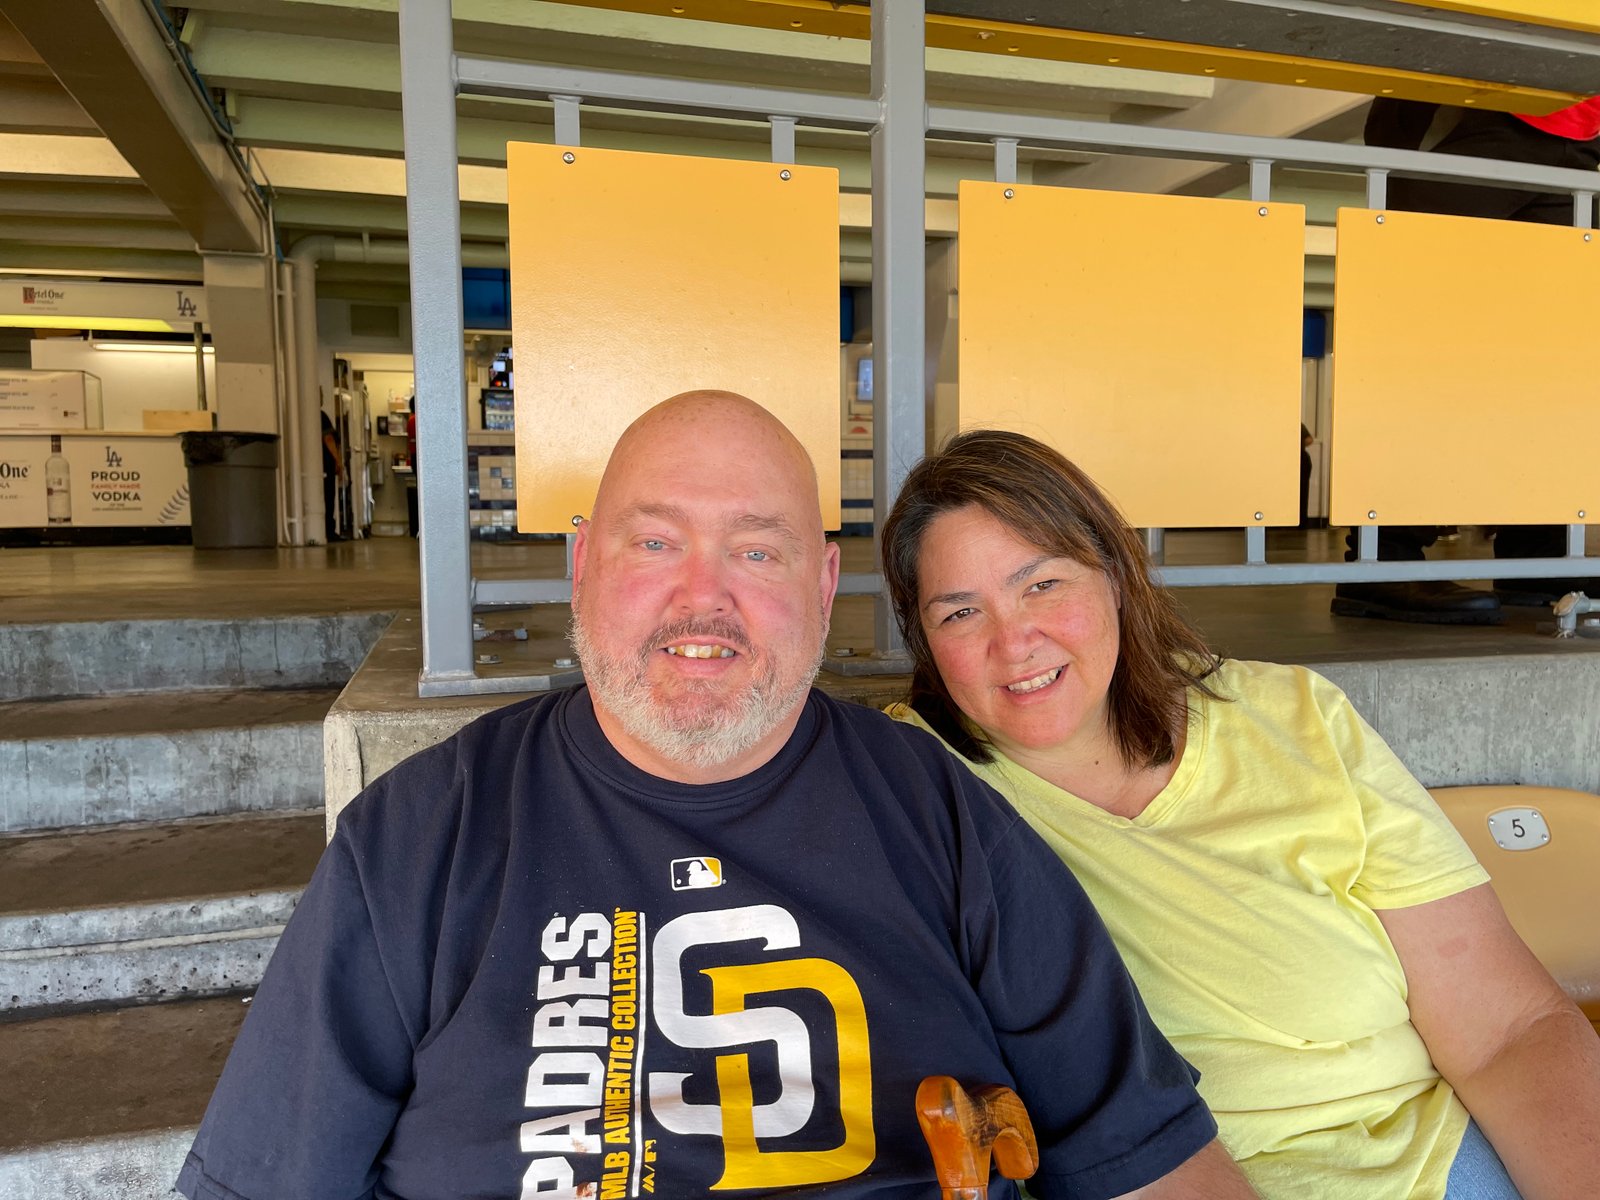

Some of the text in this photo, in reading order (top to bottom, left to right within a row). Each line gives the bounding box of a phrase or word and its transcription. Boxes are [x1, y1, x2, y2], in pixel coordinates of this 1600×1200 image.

[177, 291, 196, 317] LA
[105, 446, 122, 467] LA
[0, 462, 28, 479] One
[91, 471, 140, 481] PROUD
[92, 491, 141, 501] VODKA
[1512, 819, 1525, 838] 5
[520, 912, 611, 1200] PADRES
[600, 910, 637, 1199] MLB AUTHENTIC COLLECTION
